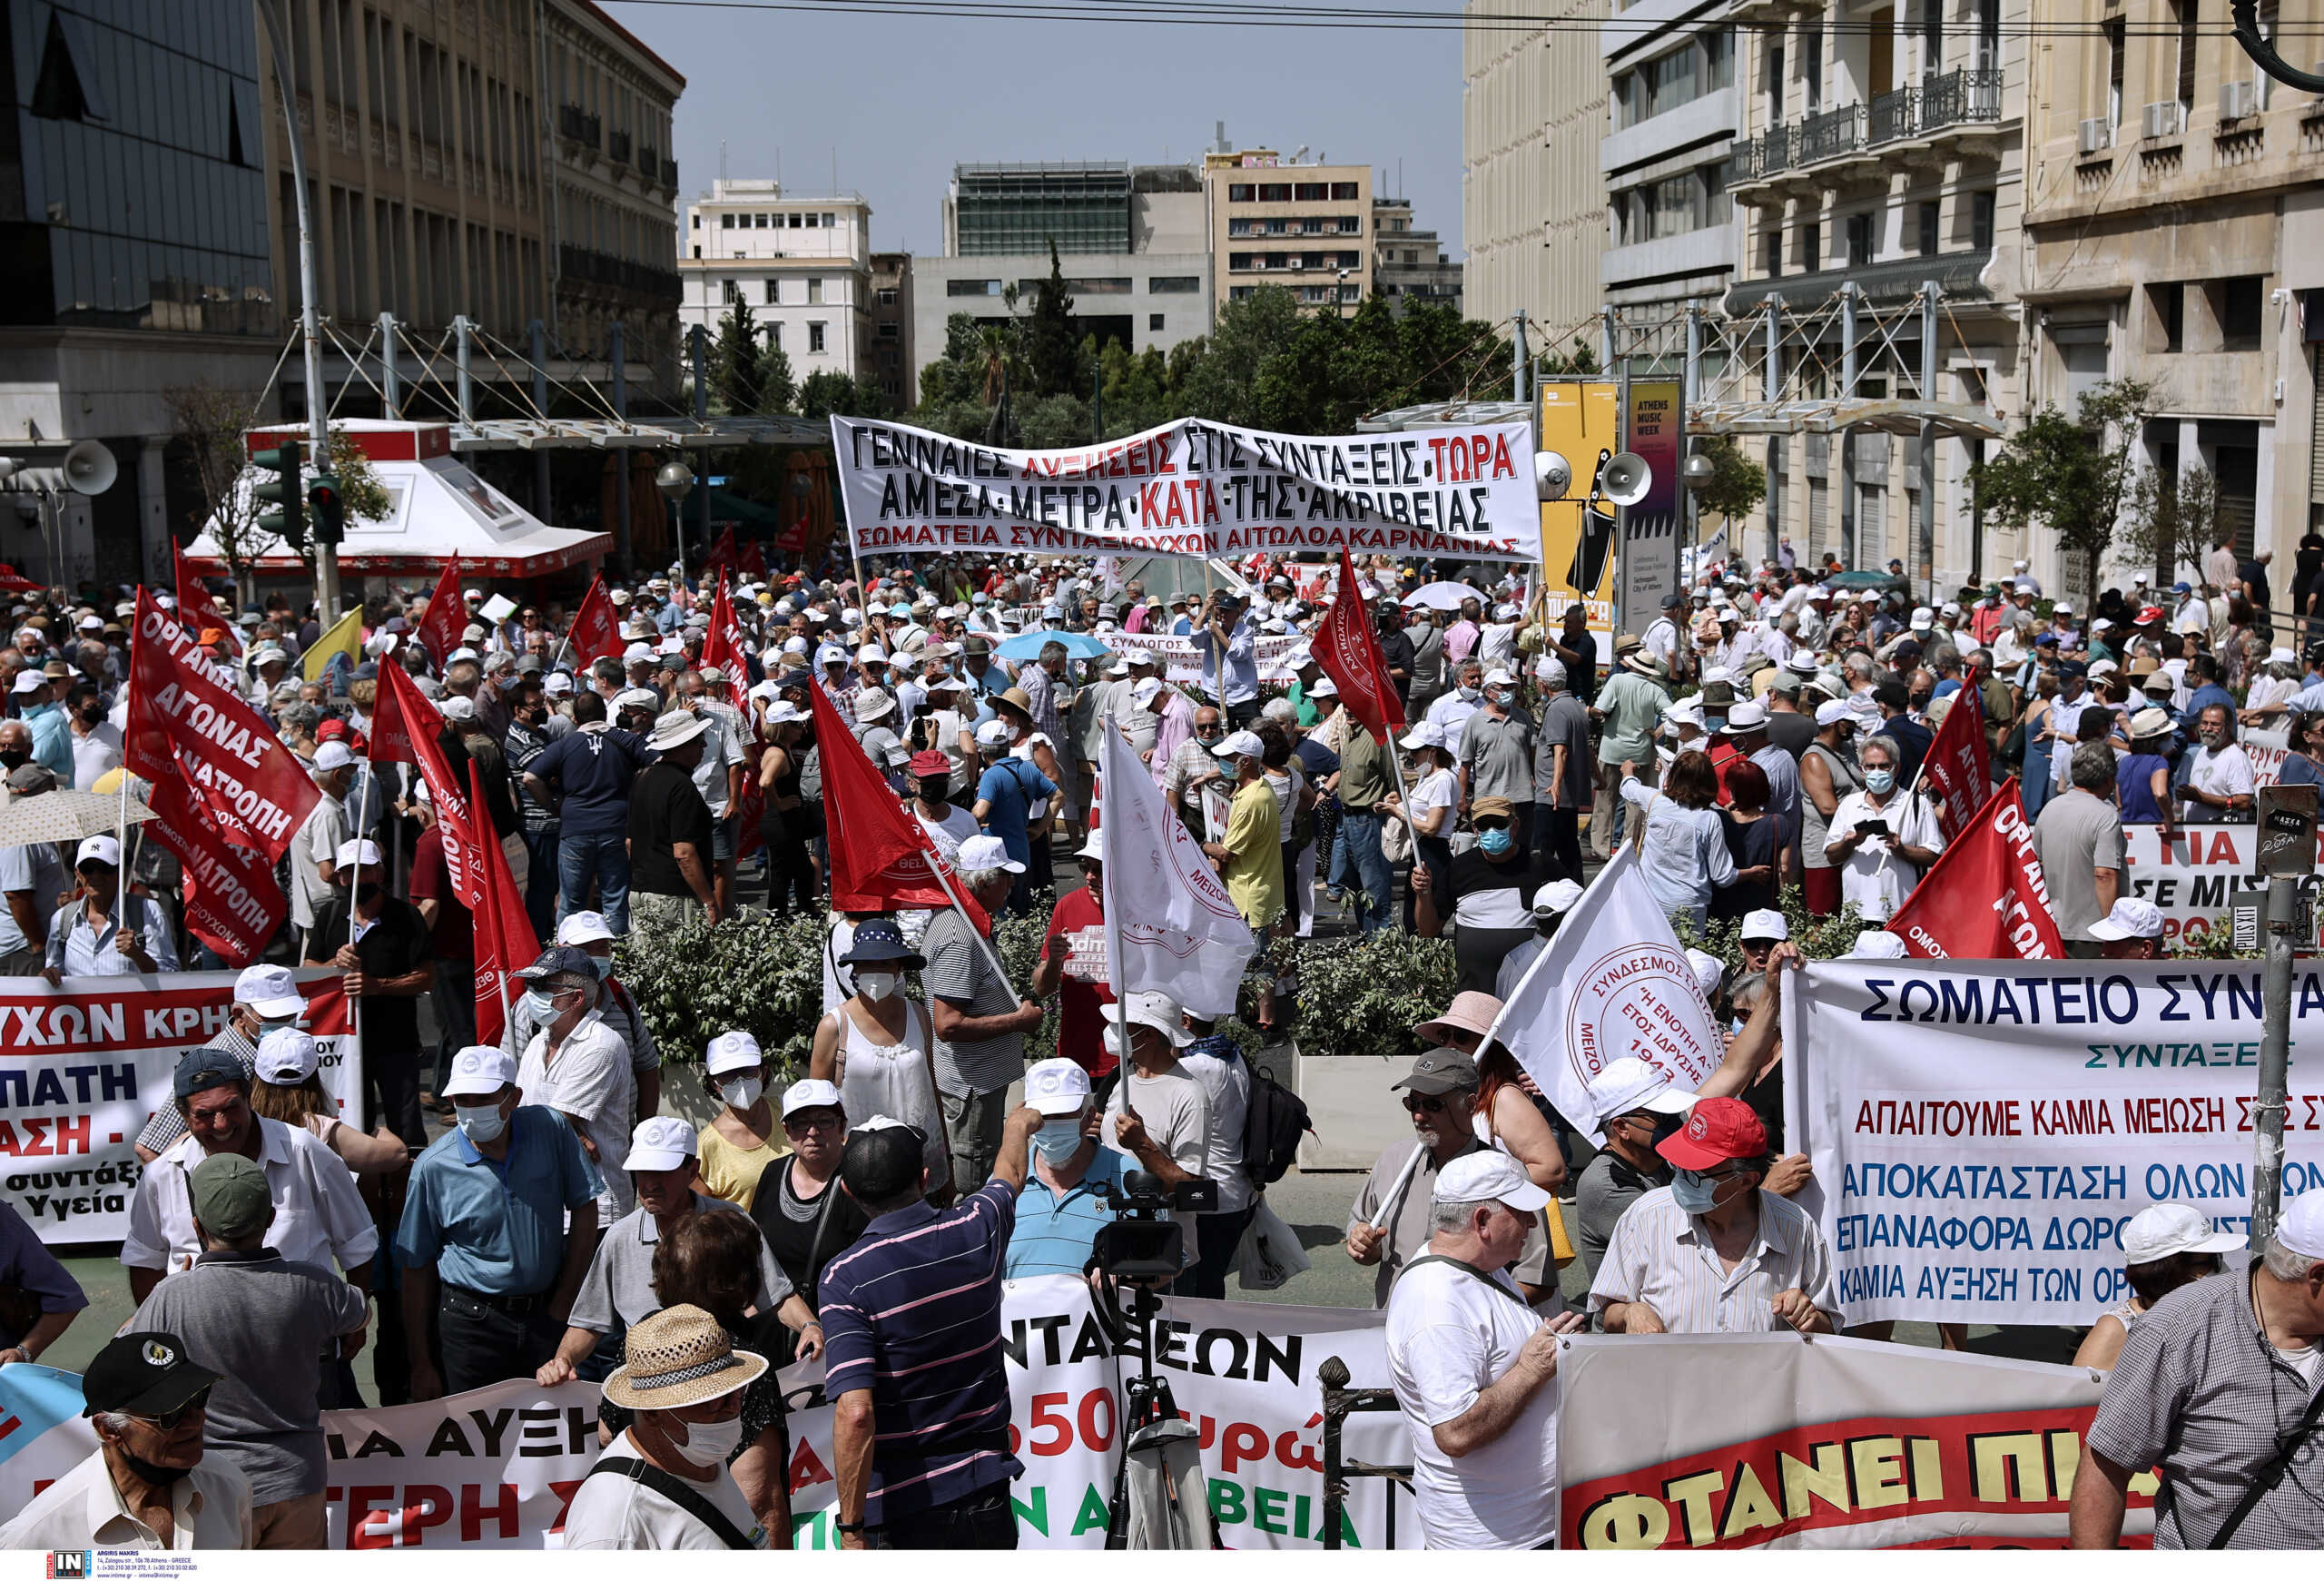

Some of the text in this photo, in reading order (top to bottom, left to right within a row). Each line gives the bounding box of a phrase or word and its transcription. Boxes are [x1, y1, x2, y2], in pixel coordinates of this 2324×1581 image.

[1638, 400, 1669, 411] ATHENS
[1638, 412, 1662, 423] MUSIC
[1638, 425, 1660, 436] WEEK
[852, 426, 1517, 487] ΓΕΝΝΑΙΕΣ ΑΥΞΗΣΕΙΣ ΣΤΙΣ ΣΥΝΤΑΞΕΙΣ ΤΩΡΑ
[1010, 484, 1128, 531] ΜΕΤΡΑ
[1140, 479, 1221, 529] ΚΑΤΑ
[1230, 475, 1295, 521] ΤΗΣ
[1306, 485, 1495, 534] ΑΚΡΙΒΕΙΑΣ
[857, 524, 1000, 549] ΣΩΜΑΤΕΙΑ
[154, 682, 271, 769] ΑΓΩΝΑΣ
[2133, 879, 2178, 907] ΣΕ
[1592, 955, 1684, 998] ΣΥΝΔΕΣΜΟΣ
[1861, 974, 2139, 1025] ΣΩΜΑΤΕΙΟ
[1621, 1003, 1657, 1037] ΕΤΟΣ
[1652, 1033, 1703, 1085] ΙΔΡΥΣΗΣ
[1855, 1099, 2022, 1136] ΑΠΑΙΤΟΥΜΕ
[2031, 1098, 2115, 1135] ΚΑΜΙΑ
[2123, 1096, 2225, 1133] ΜΕΙΩΣΗ
[1843, 1163, 2126, 1200] ΑΠΟΚΑΤΑΣΤΑΣΗ
[2145, 1162, 2246, 1201] ΟΛΩΝ
[25, 1188, 124, 1222] Υγεία
[1837, 1213, 2034, 1251] ΕΠΑΝΑΦΟΡΑ
[1839, 1264, 1905, 1304] ΚΑΜΙΑ
[1916, 1265, 2018, 1301] ΑΥΞΗΣΗ
[2027, 1268, 2082, 1301] ΤΩΝ
[1581, 1435, 1944, 1549] ΦΤΑΝΕΙ
